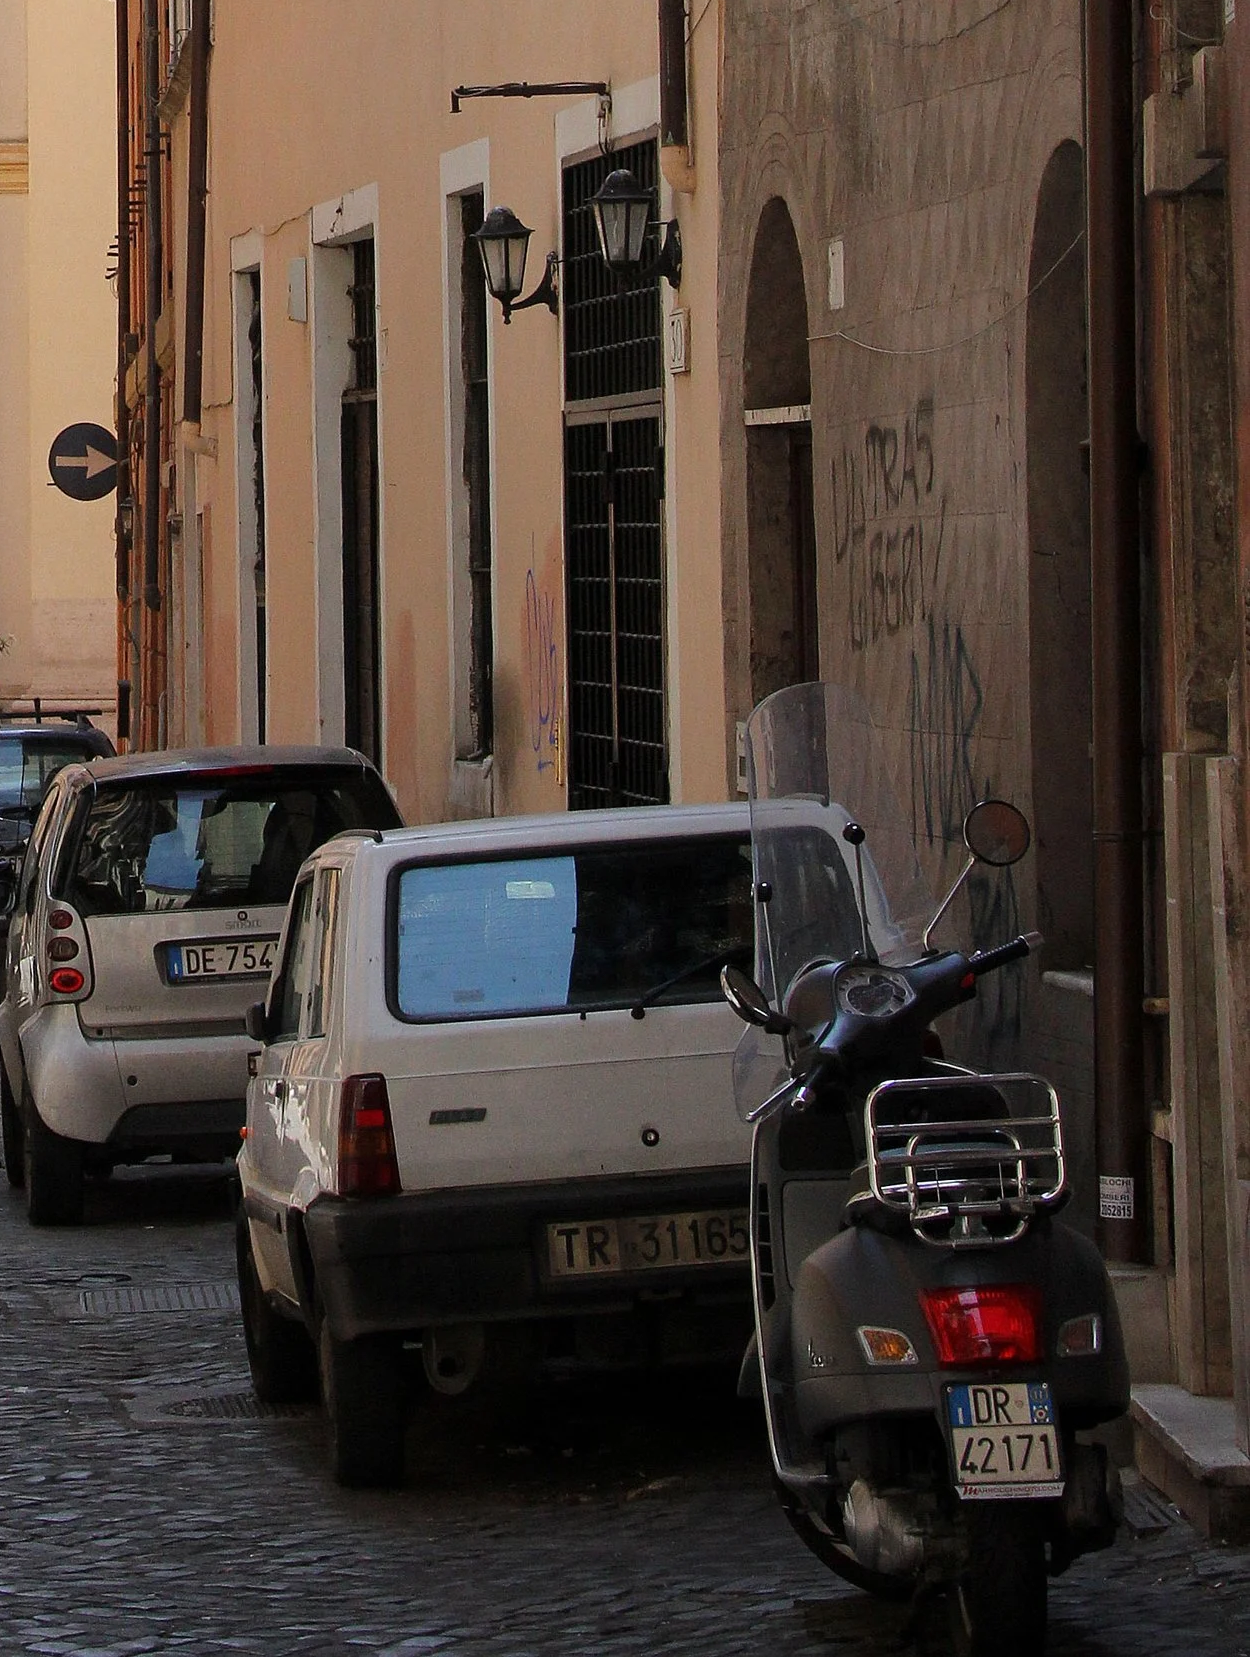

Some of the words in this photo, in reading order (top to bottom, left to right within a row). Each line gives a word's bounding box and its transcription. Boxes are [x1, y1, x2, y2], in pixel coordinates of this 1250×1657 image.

[185, 948, 217, 974] DE
[226, 944, 276, 971] 754
[556, 1225, 611, 1268] TR
[972, 1387, 1013, 1424] DR
[959, 1433, 1053, 1474] 42171
